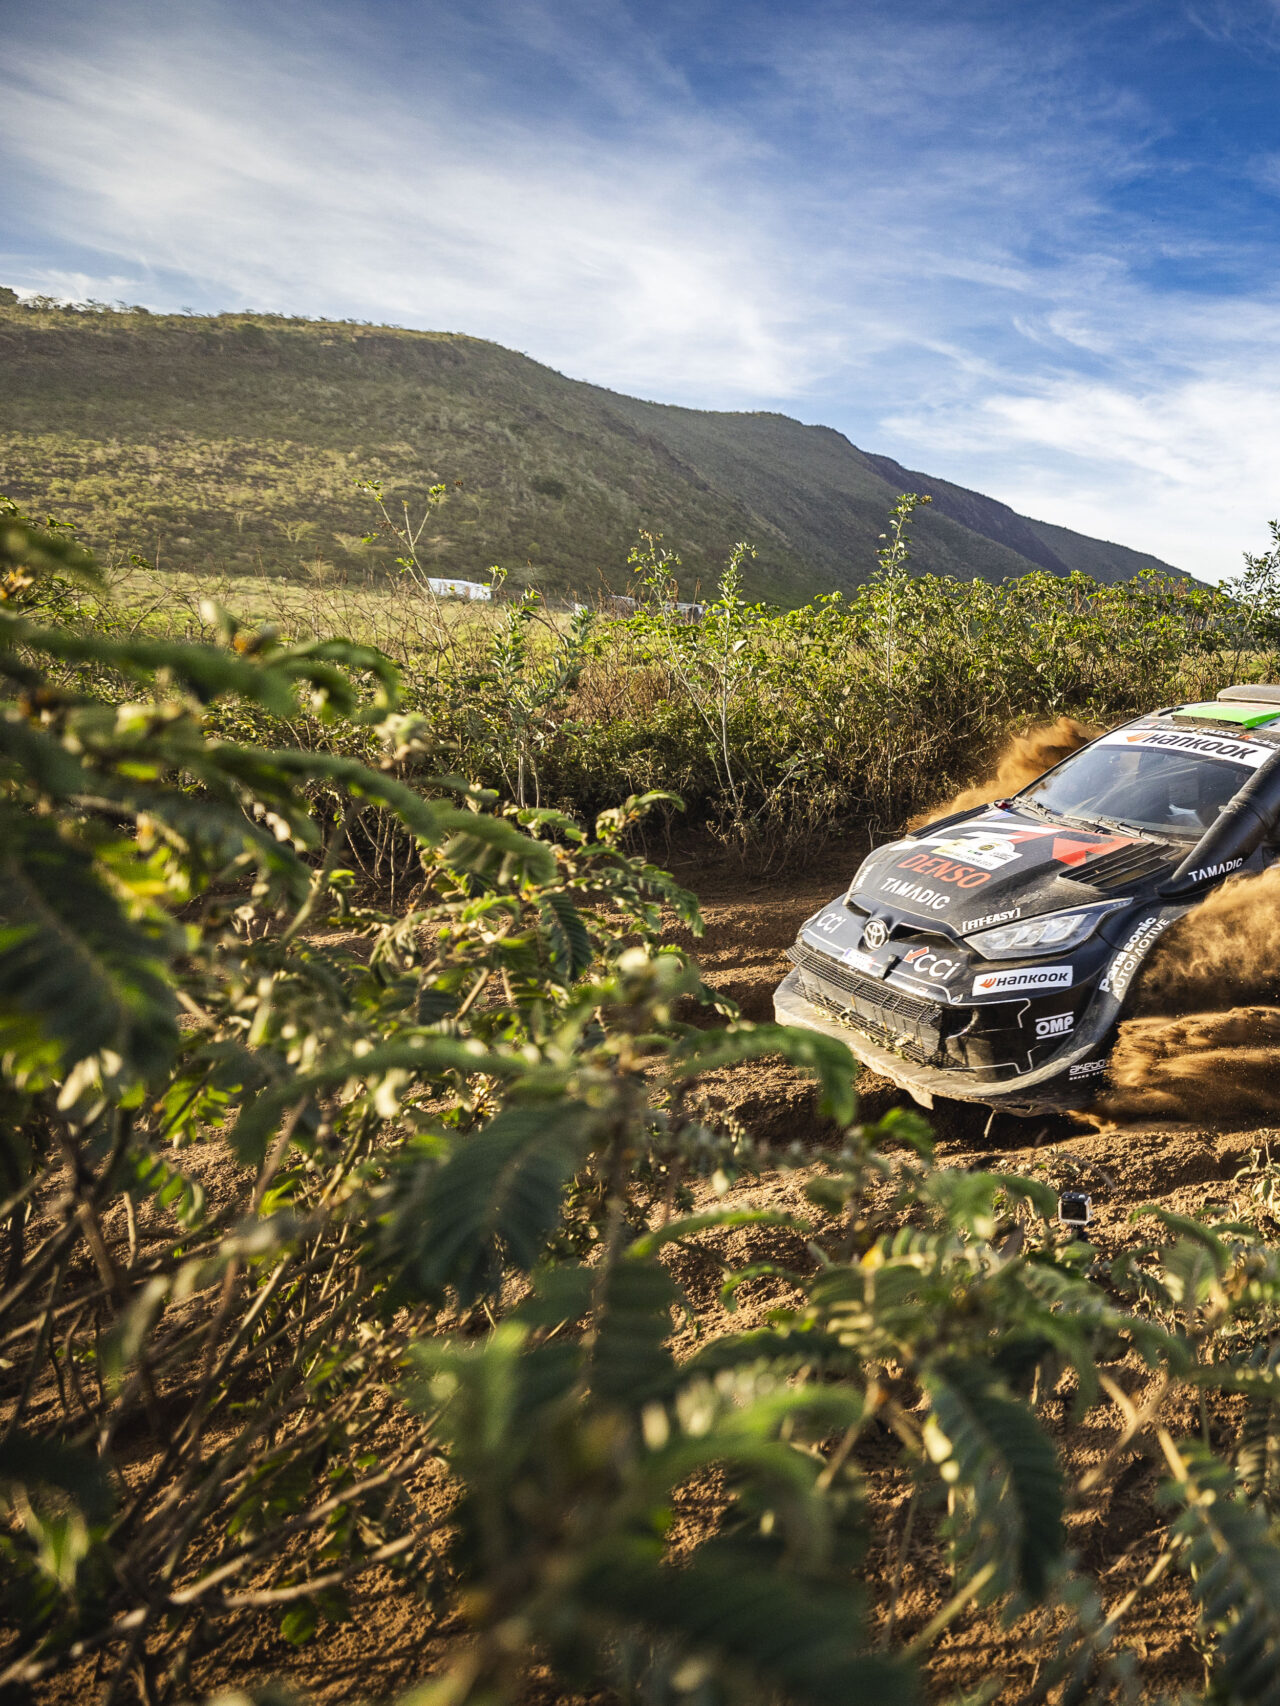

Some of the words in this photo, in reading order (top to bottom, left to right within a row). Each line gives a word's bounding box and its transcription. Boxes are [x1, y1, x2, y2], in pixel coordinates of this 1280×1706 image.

[896, 853, 991, 889] DENSO
[1188, 857, 1243, 882] TAMADIC
[880, 877, 950, 910] TAMADIC
[1099, 917, 1157, 993] Panasonic
[1112, 918, 1170, 999] AUTOMOTIVE
[1035, 1015, 1075, 1036] OMP
